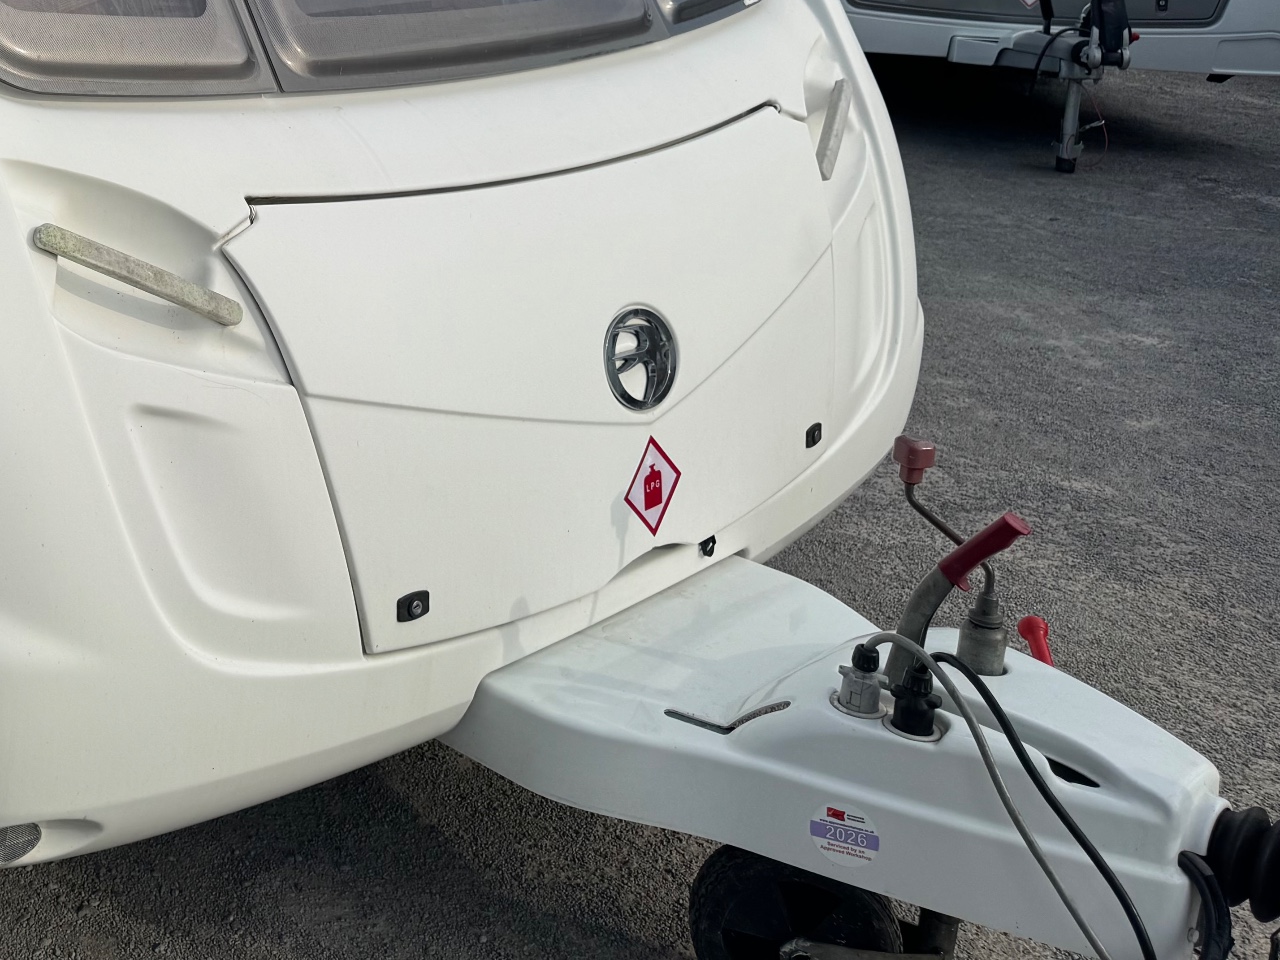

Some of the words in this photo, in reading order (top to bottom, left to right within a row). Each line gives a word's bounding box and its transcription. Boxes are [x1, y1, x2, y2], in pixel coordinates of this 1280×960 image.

[645, 479, 660, 493] LPG
[825, 825, 867, 847] 2026
[820, 844, 845, 855] Approved
[845, 850, 873, 862] Workshop
[827, 841, 850, 851] Serviced
